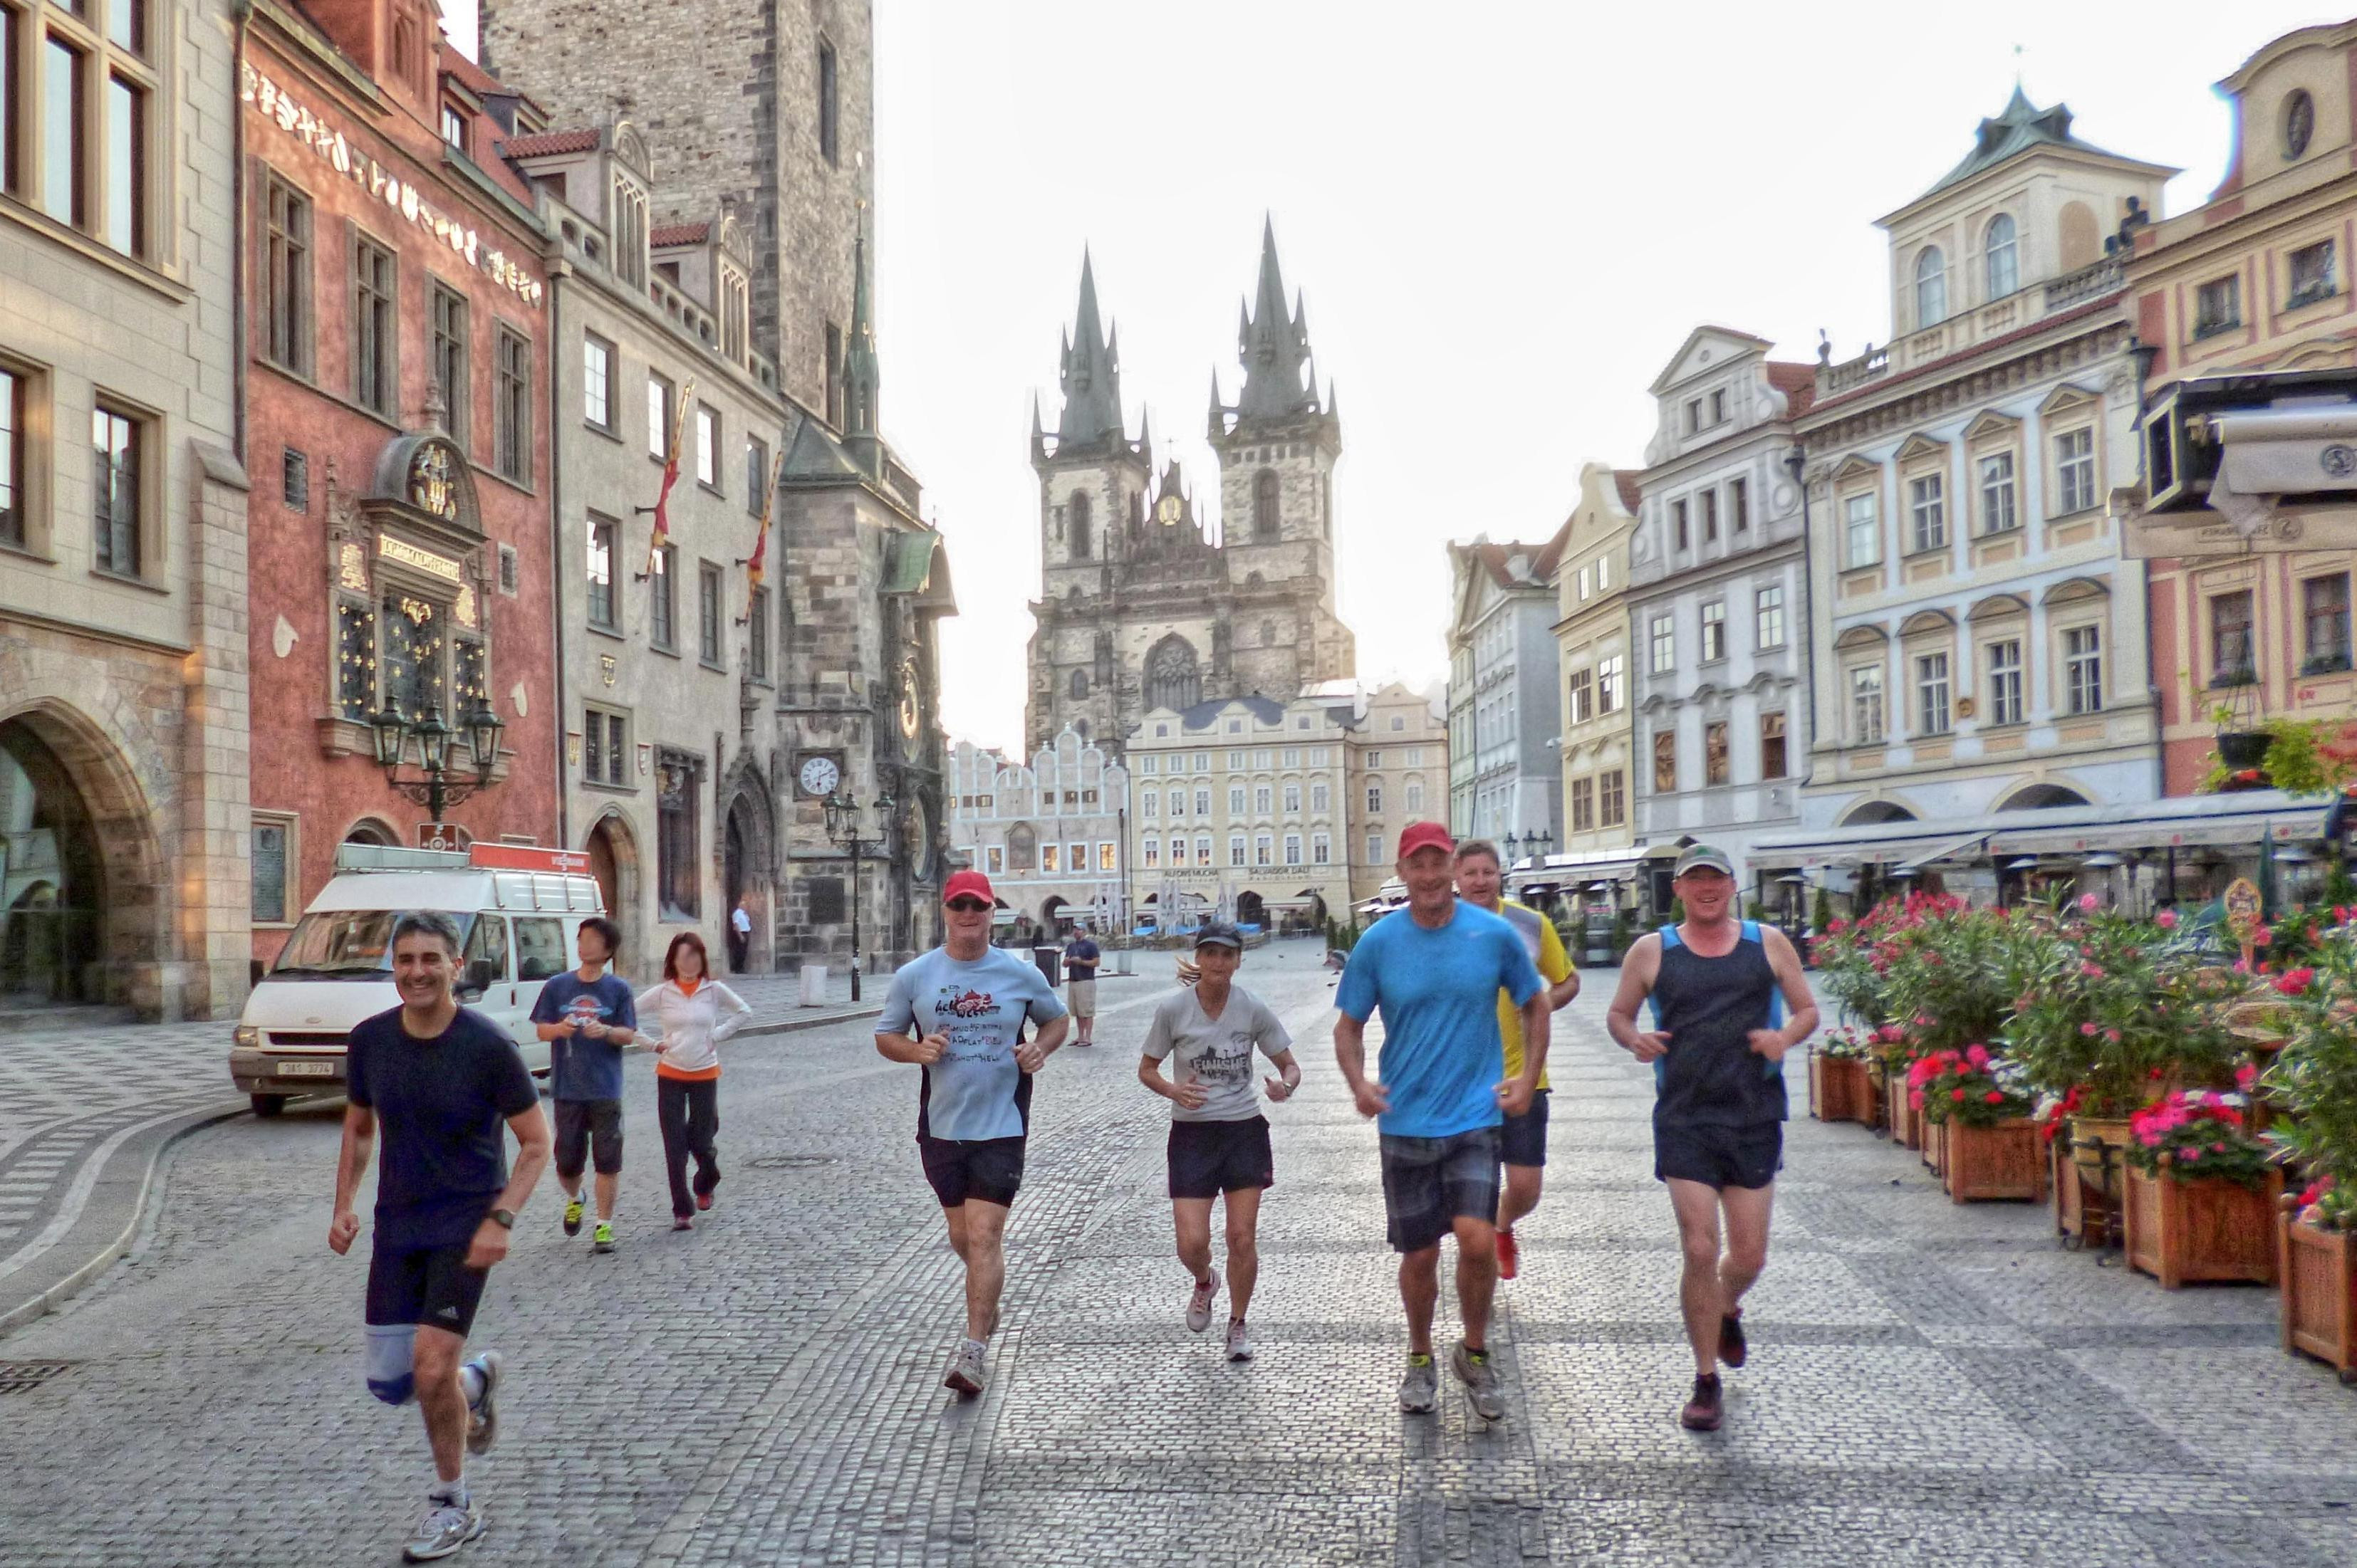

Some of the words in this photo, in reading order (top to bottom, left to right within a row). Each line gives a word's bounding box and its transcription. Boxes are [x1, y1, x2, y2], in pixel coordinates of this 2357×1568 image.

[1164, 869, 1192, 878] ALFONS
[1192, 869, 1219, 877] MUCHA
[1248, 867, 1289, 875] SALVADOR
[1193, 1057, 1248, 1071] FINISHE
